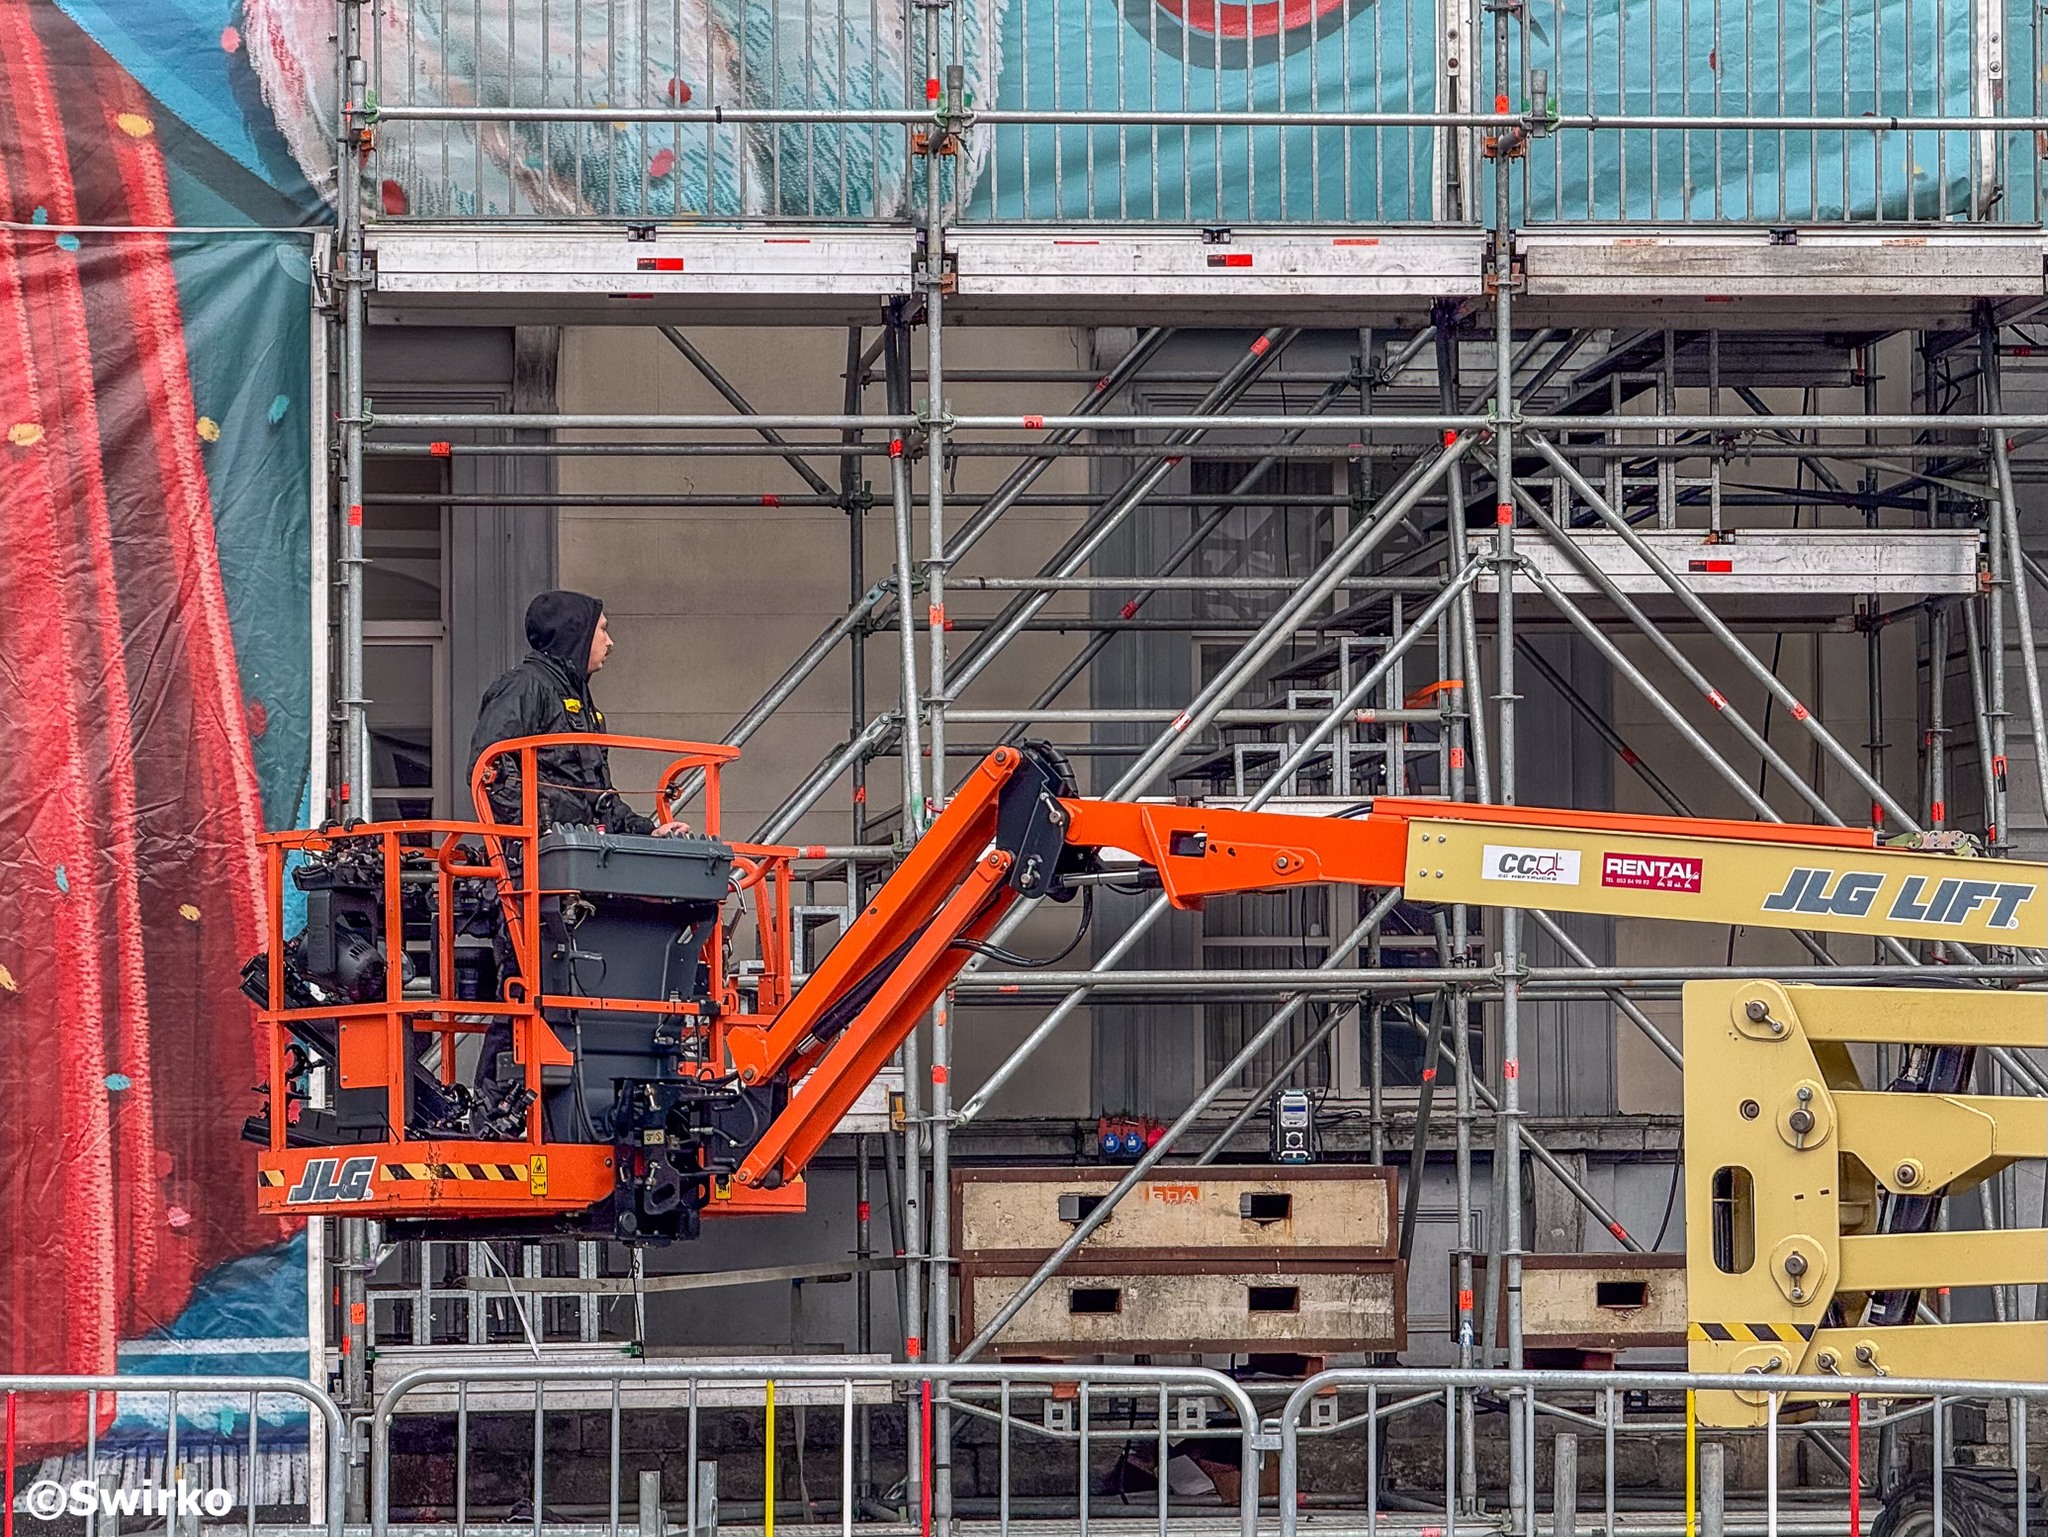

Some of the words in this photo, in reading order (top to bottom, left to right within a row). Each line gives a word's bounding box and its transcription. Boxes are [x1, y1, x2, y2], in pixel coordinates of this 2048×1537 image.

[1498, 853, 1537, 875] CC
[1605, 857, 1700, 880] RENTAL
[1760, 866, 1888, 918] JLG
[1886, 874, 2038, 929] LIFT
[286, 1155, 378, 1205] JLG
